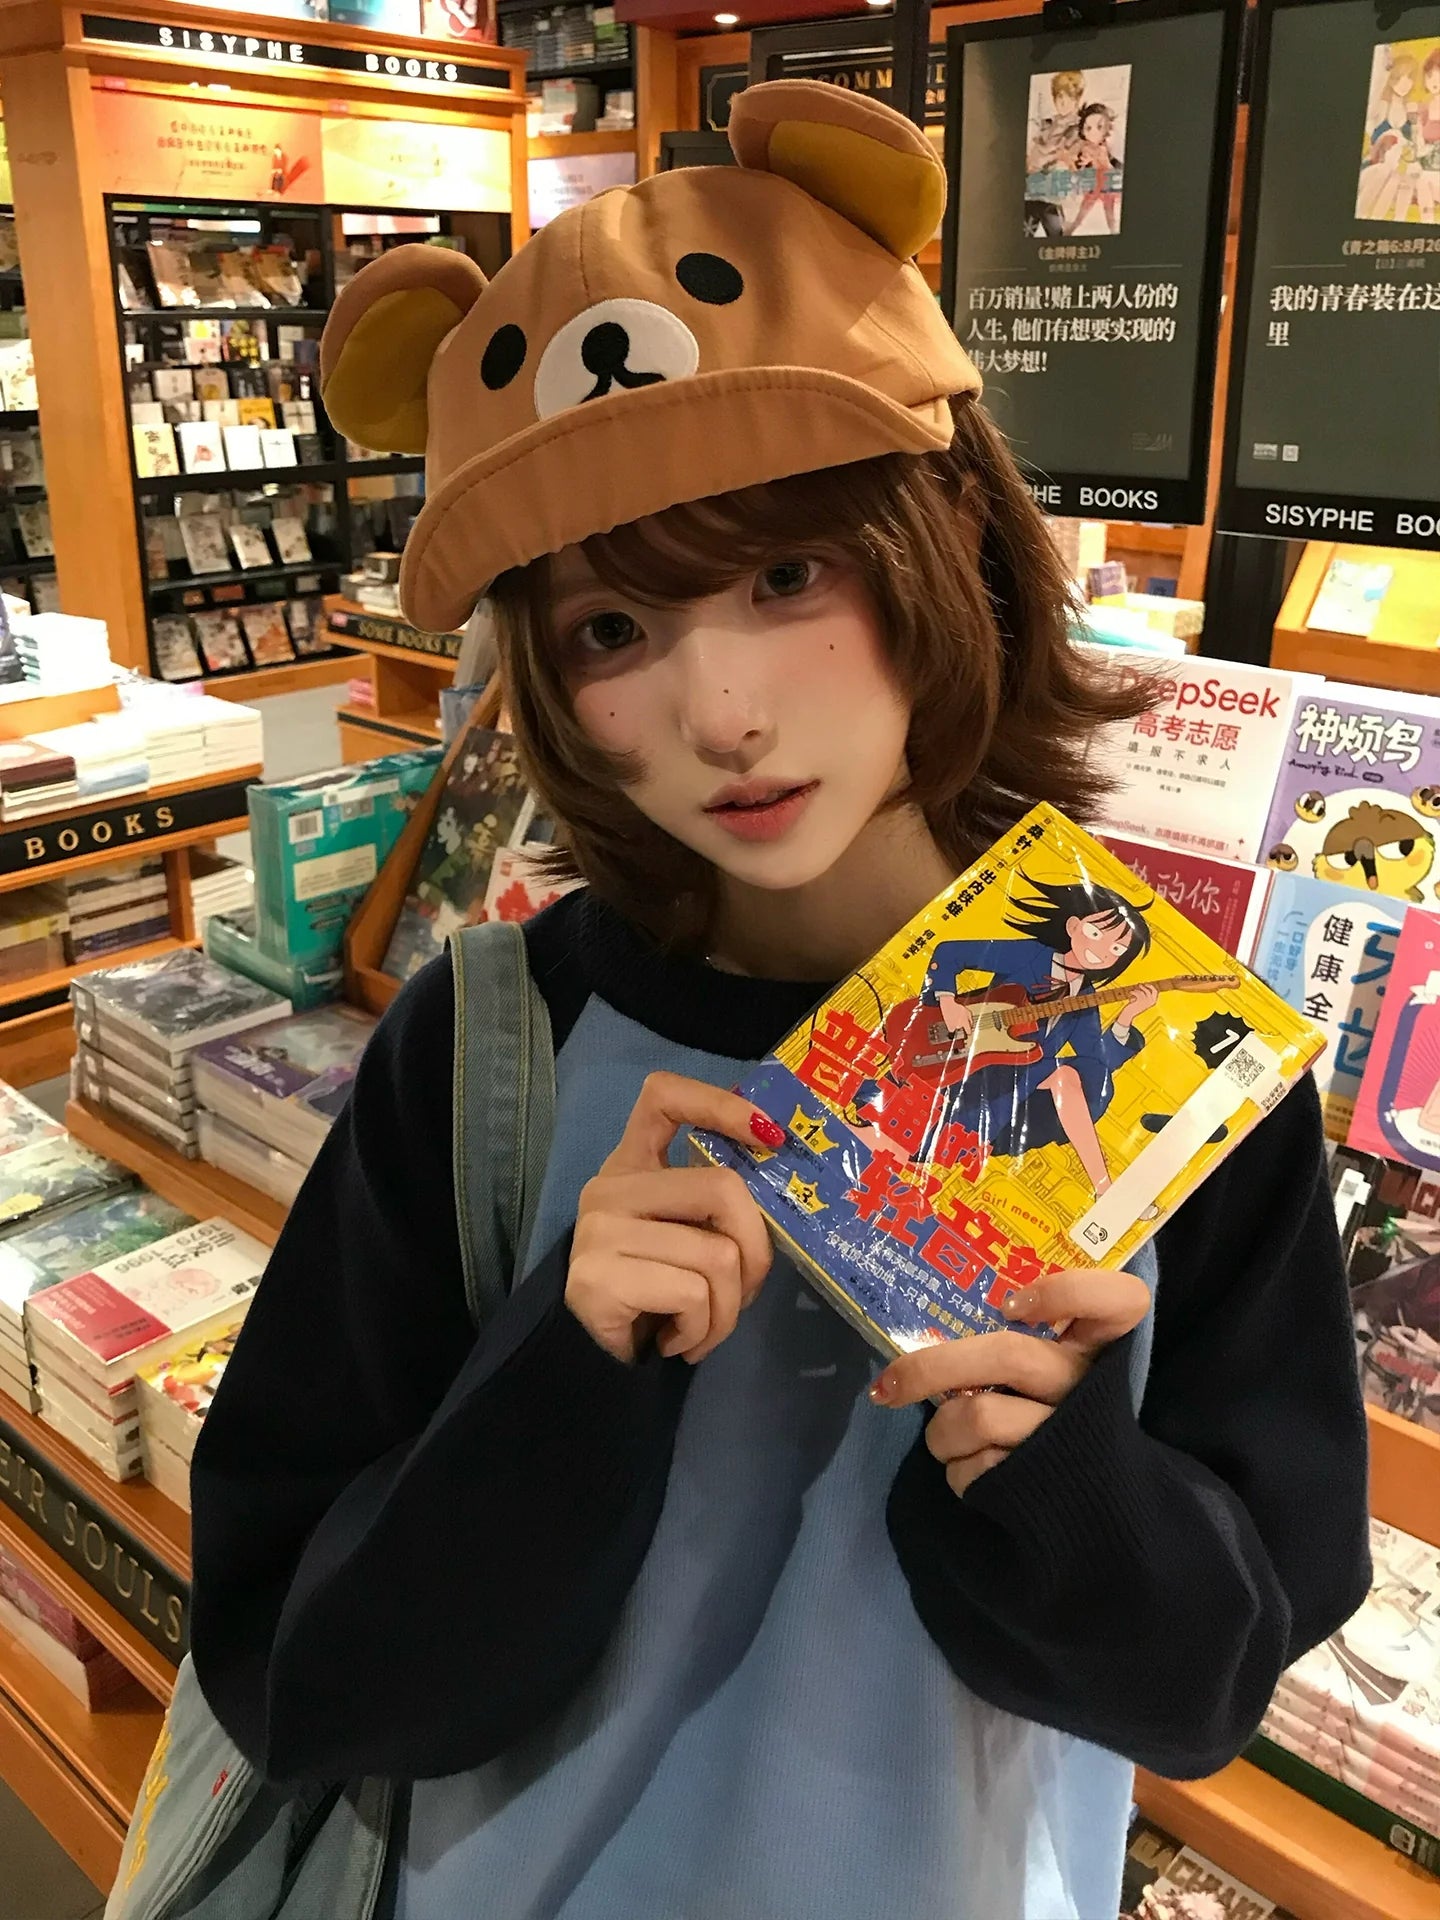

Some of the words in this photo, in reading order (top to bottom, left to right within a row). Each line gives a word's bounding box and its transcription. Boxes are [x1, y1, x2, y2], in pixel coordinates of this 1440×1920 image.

[159, 27, 304, 62] SISYPHE
[366, 54, 458, 82] BOOKS
[968, 282, 1179, 311] 百万销量!赌上两人份的
[1269, 282, 1440, 312] 我的青春装在这
[1265, 320, 1290, 347] 里
[1080, 486, 1159, 511] BOOKS
[1265, 503, 1375, 533] SISYPHE
[1396, 513, 1440, 538] BO
[397, 628, 440, 654] BOOKS
[1132, 710, 1242, 752] 高考志愿
[1294, 703, 1425, 773] 神烦鸟
[24, 806, 175, 860] BOOKS
[1209, 1028, 1240, 1054] 1
[795, 1009, 993, 1183] 普通的
[982, 1191, 1008, 1209] Girl
[1010, 1204, 1051, 1235] meets
[869, 1238, 1009, 1332] 没有天赋异禀、只有永不
[62, 1501, 182, 1644] SOULS
